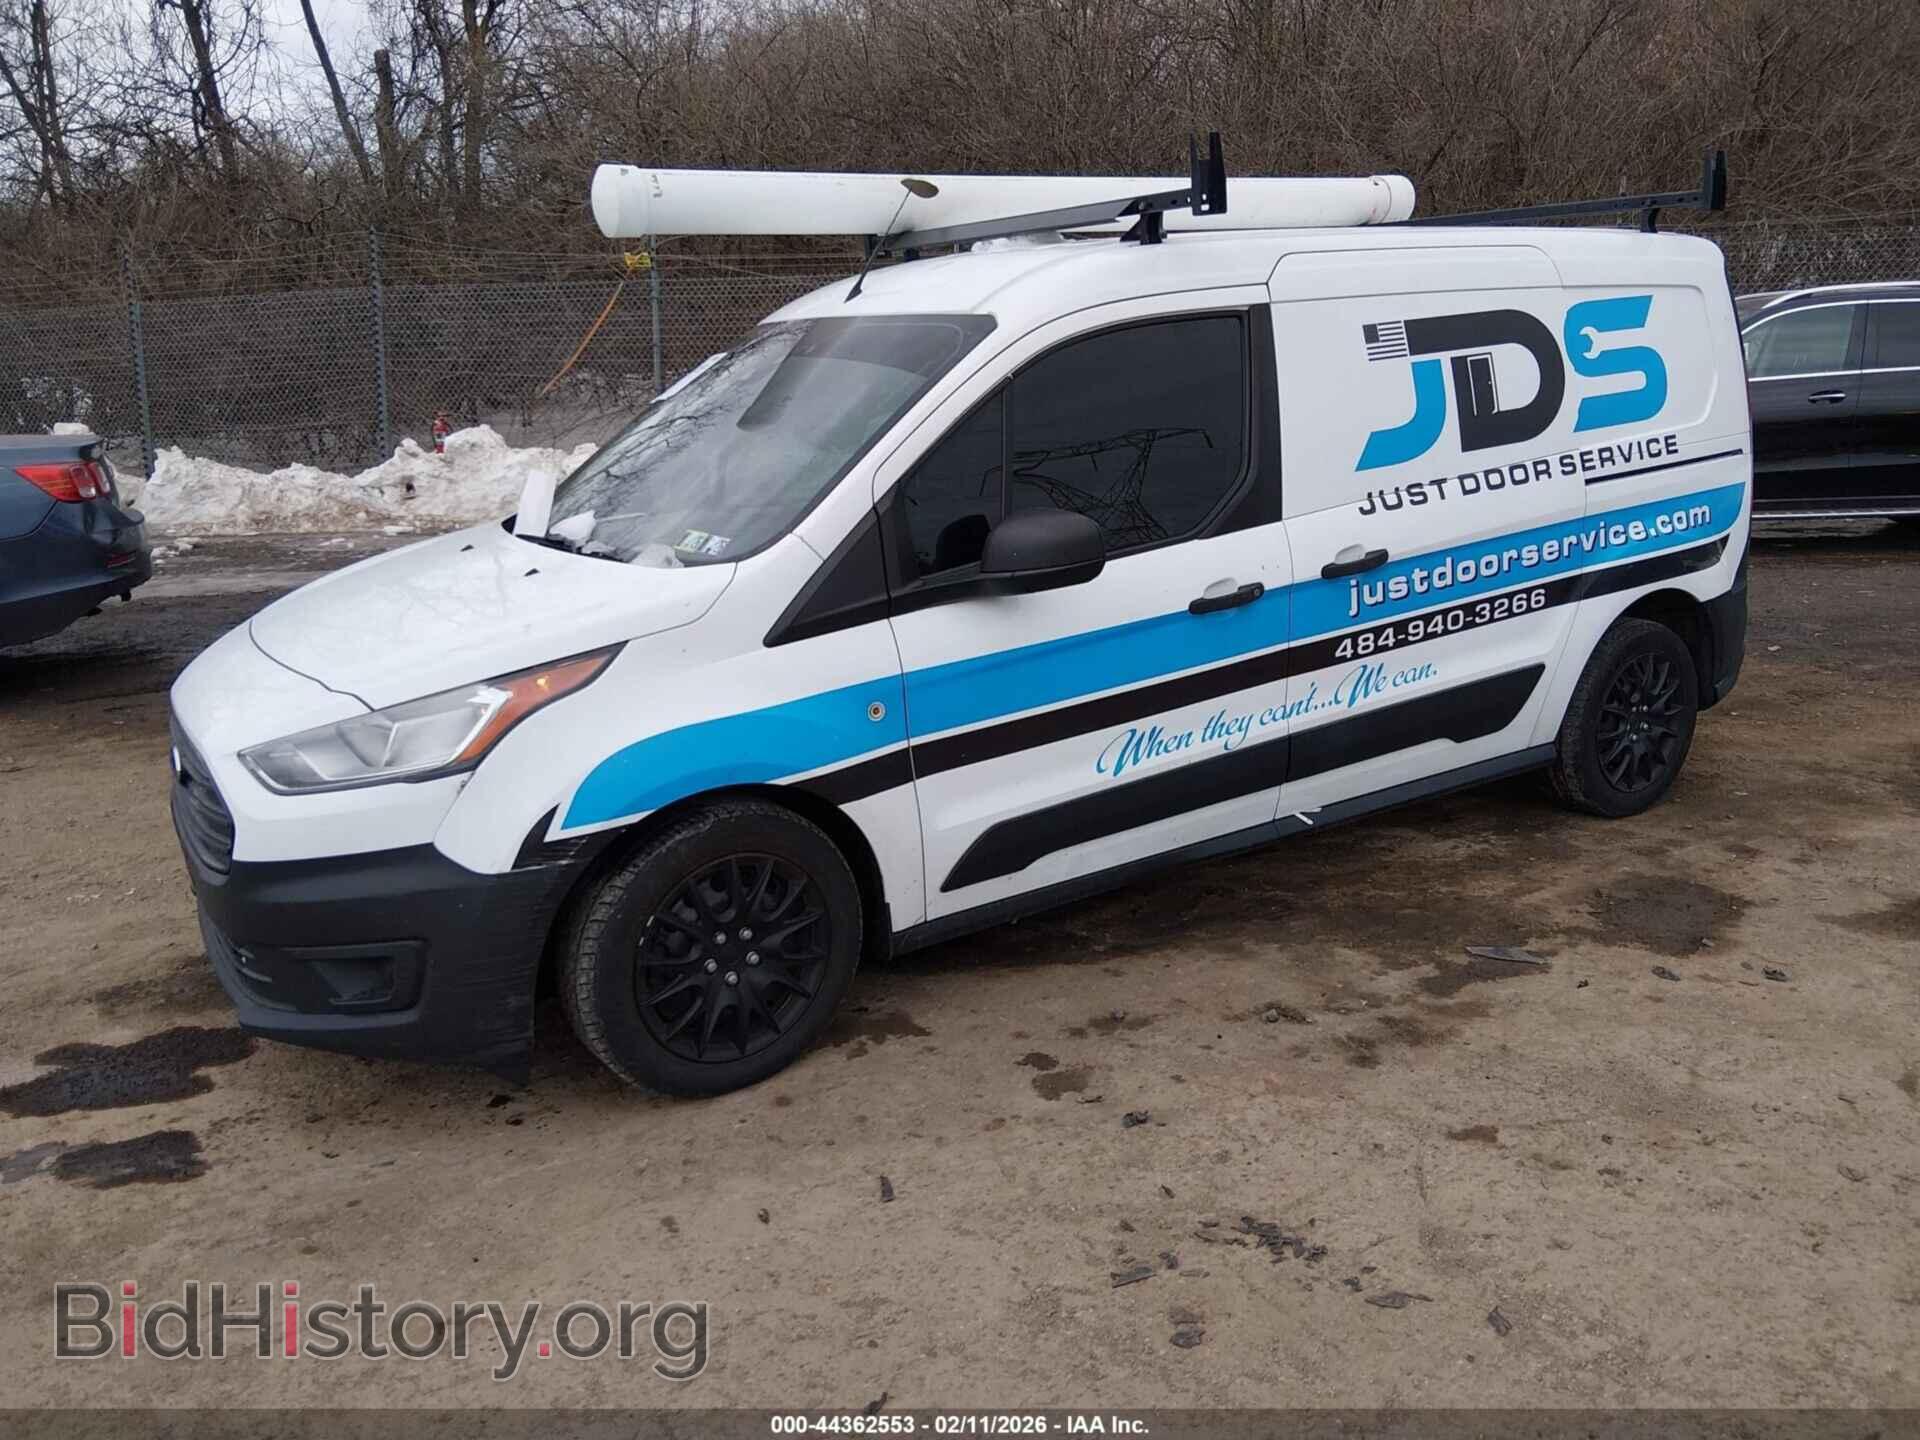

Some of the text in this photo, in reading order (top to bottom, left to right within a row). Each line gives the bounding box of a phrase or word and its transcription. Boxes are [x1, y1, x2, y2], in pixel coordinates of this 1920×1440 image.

[1355, 294, 1668, 472] JDS
[1358, 433, 1679, 516] JUST DOOR SERVICE
[1348, 503, 1713, 617] justdoorservice.com
[1335, 588, 1546, 659] 484-940-3266
[1096, 725, 1193, 777] When
[1201, 708, 1254, 751] they
[1392, 663, 1438, 688] can.
